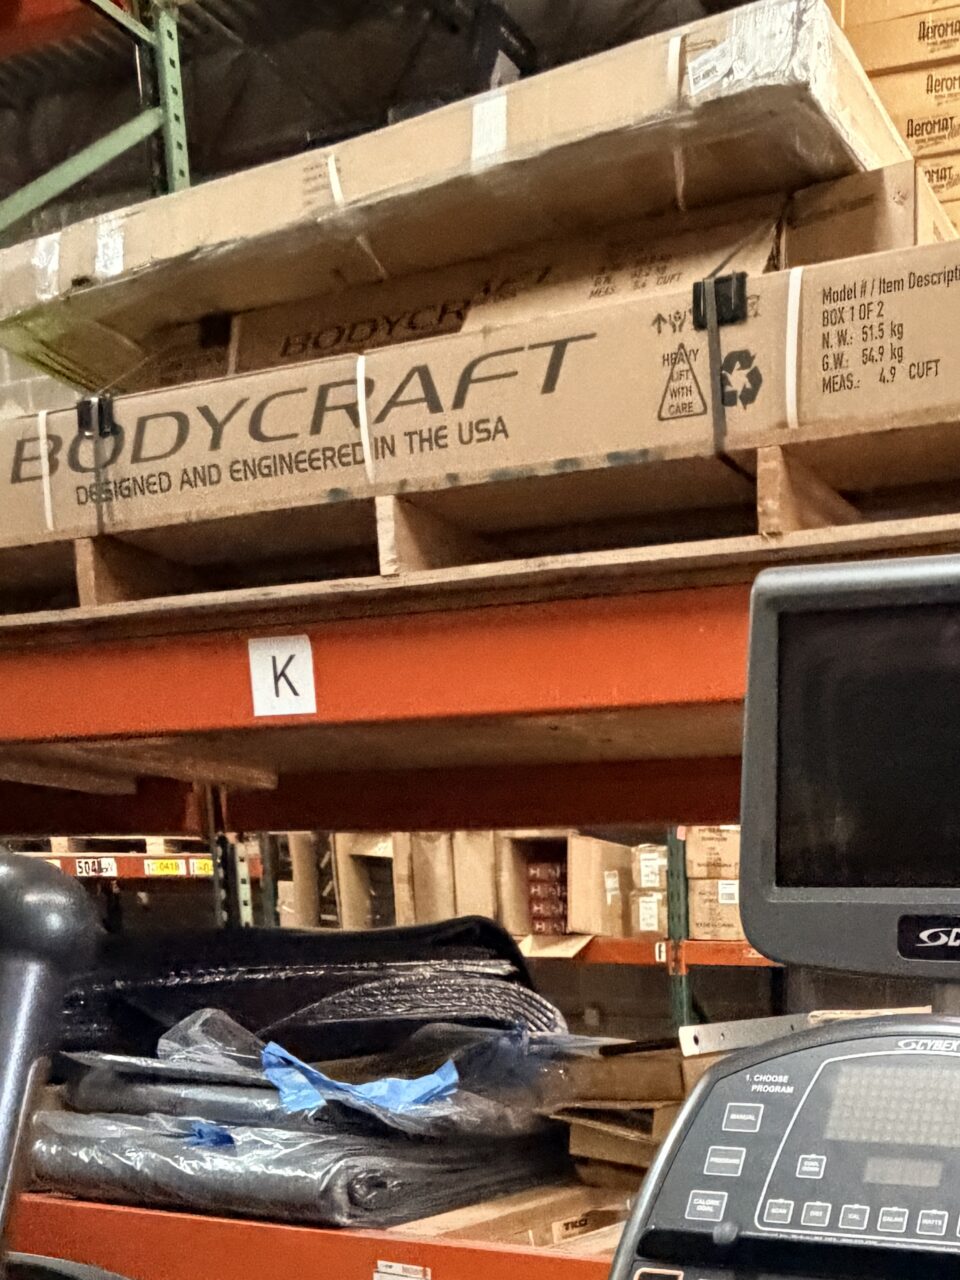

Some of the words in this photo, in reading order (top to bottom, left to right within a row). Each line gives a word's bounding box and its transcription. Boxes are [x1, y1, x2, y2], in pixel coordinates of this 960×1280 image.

[823, 282, 857, 304] Model
[879, 278, 904, 295] Item
[823, 308, 846, 328] BOX
[850, 306, 855, 322] 1
[858, 303, 874, 320] OF
[877, 301, 884, 318] 2
[890, 321, 904, 340] kg
[662, 349, 699, 367] HEAVY
[862, 346, 884, 365] 54.9
[890, 343, 904, 363] kg
[671, 369, 689, 382] LIFT
[879, 366, 896, 384] 4.9
[909, 359, 940, 380] CUFT
[669, 384, 693, 399] WITH
[10, 332, 597, 484] BODYCRAFT
[668, 401, 694, 416] CARE
[76, 471, 172, 505] DESIGNED
[179, 462, 222, 491] AND
[229, 441, 366, 482] ENGINEERED
[374, 433, 396, 460] IN
[404, 424, 449, 455] THE
[458, 416, 510, 446] USA
[271, 653, 300, 698] K
[751, 1084, 794, 1094] PROGRAM
[754, 1074, 789, 1084] CHOOSE
